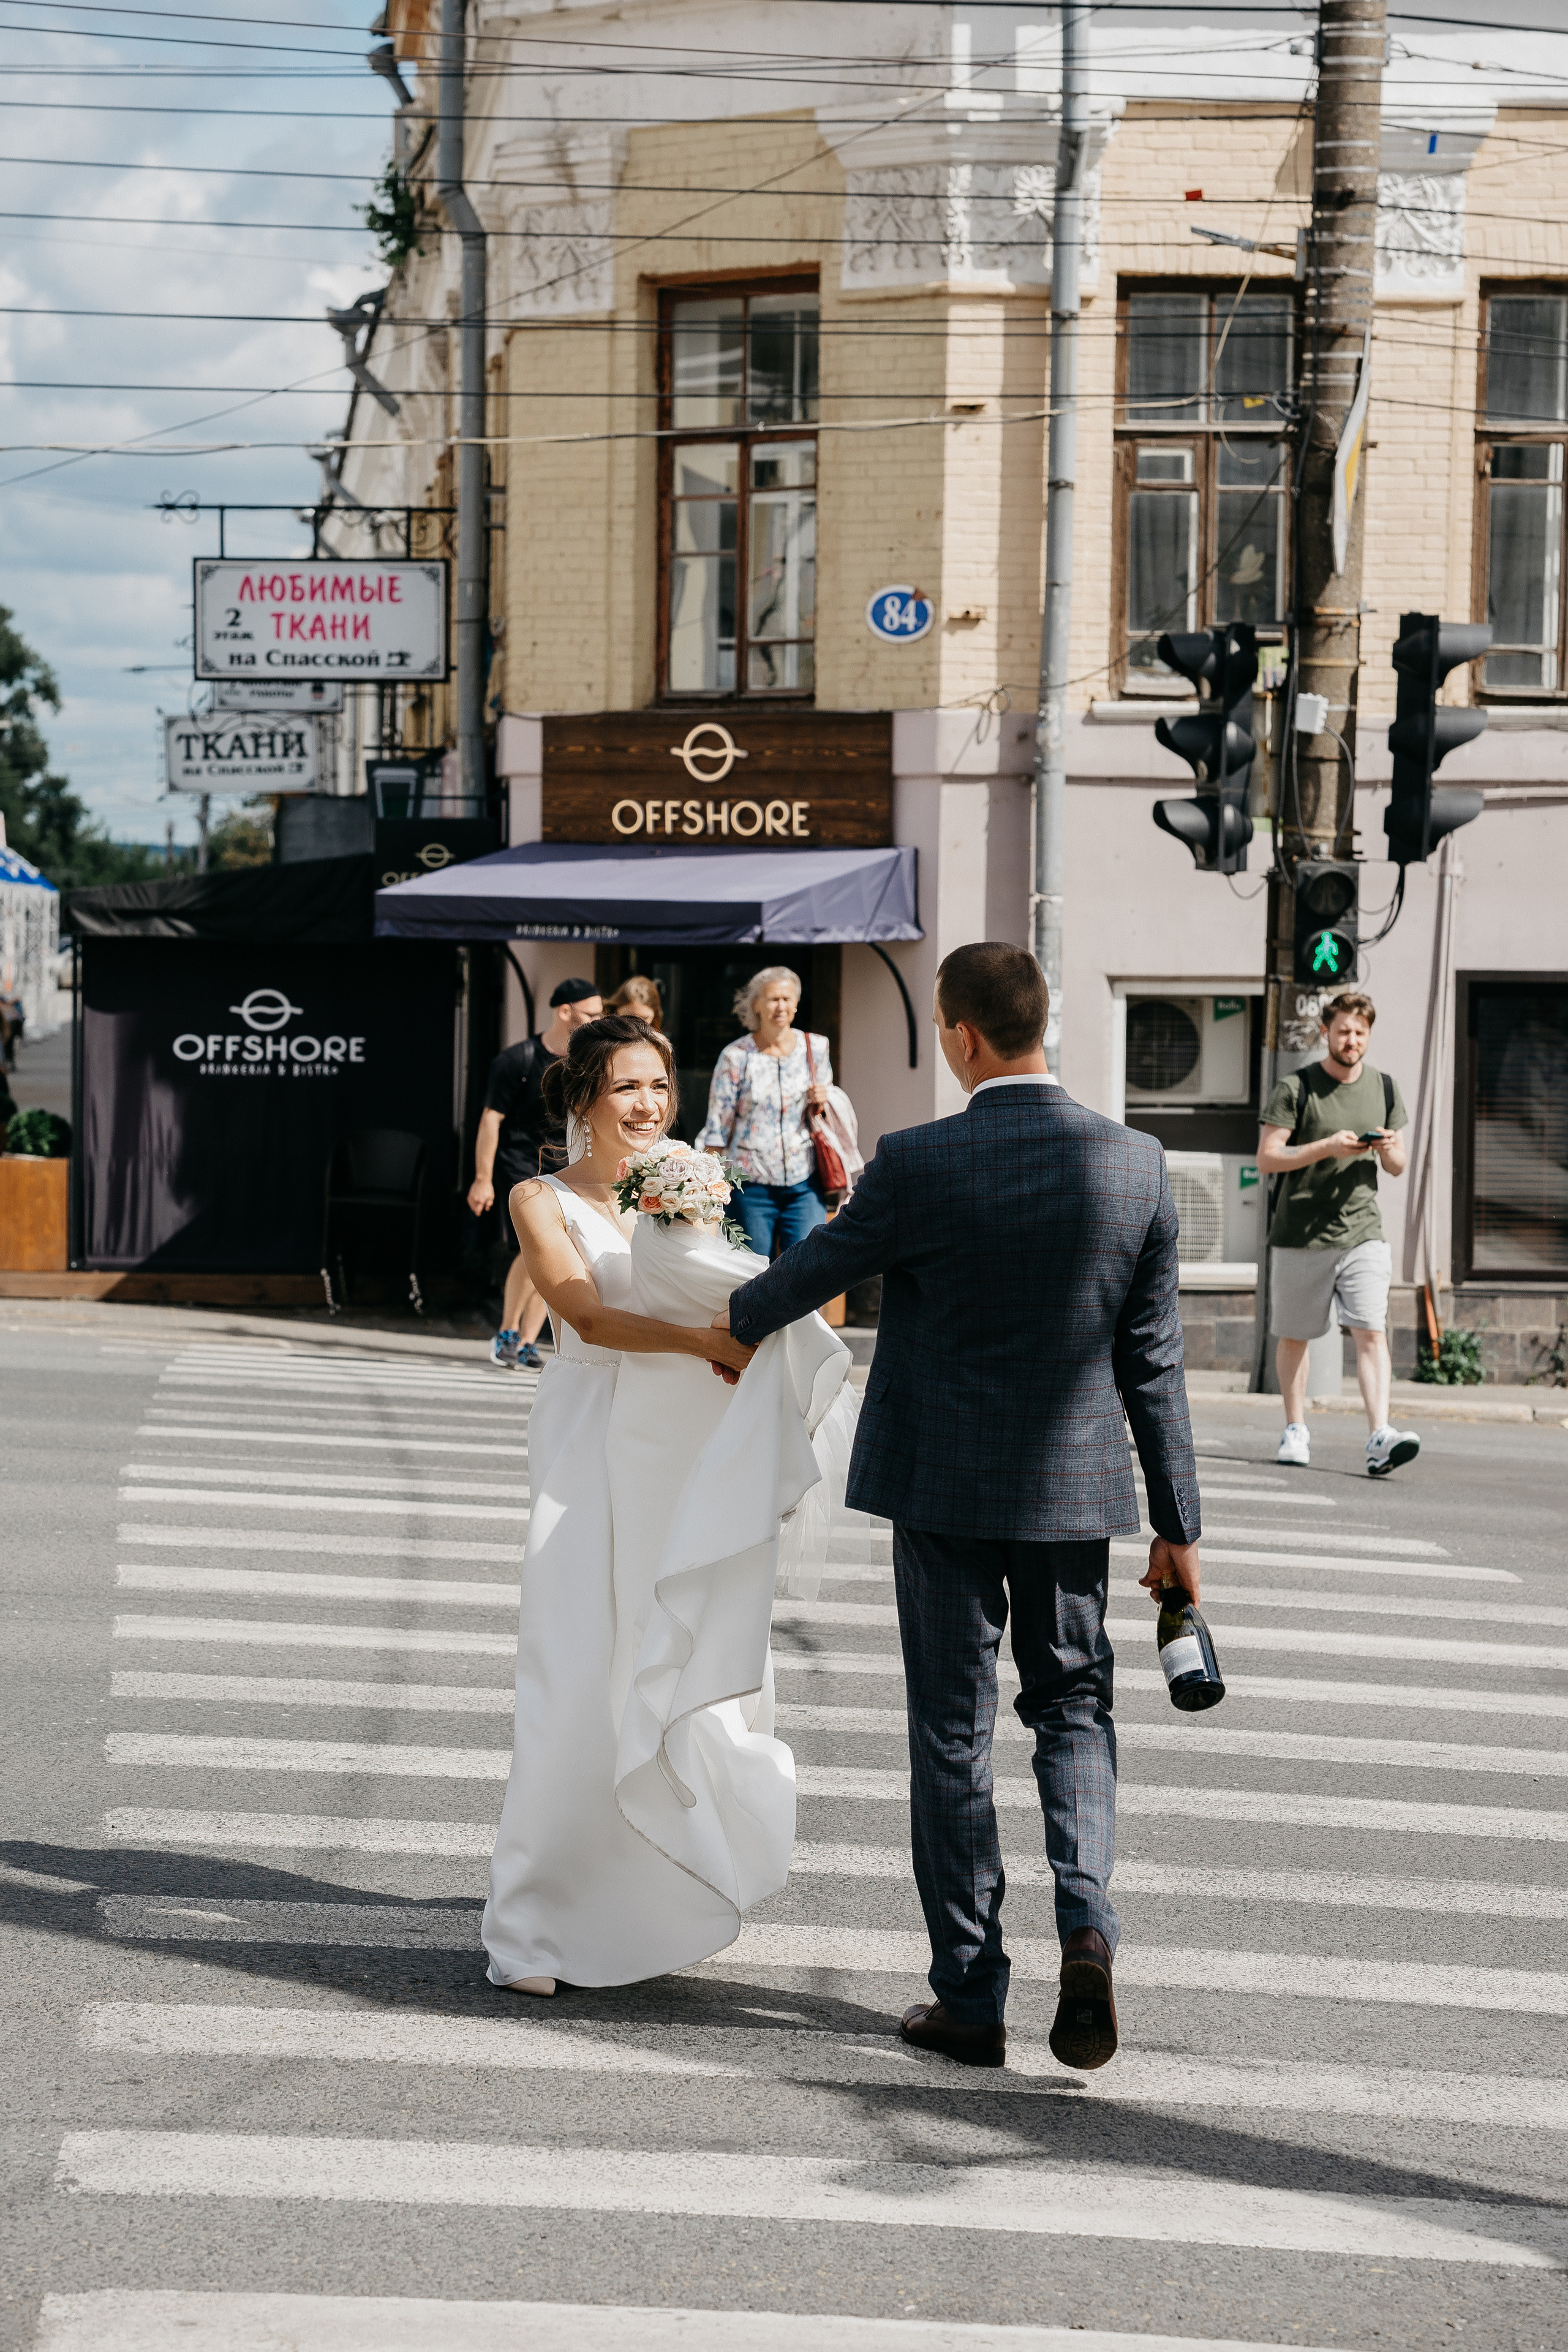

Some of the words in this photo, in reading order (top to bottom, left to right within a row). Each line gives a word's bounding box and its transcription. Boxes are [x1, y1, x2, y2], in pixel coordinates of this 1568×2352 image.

[238, 574, 403, 603] ЛЮБИМЫЕ
[225, 607, 241, 627] 2
[270, 612, 370, 641] ТКАНИ
[882, 595, 918, 632] 84
[229, 652, 257, 666] на
[265, 648, 380, 667] Спасской
[176, 731, 308, 760] ТКАНИ
[611, 799, 810, 836] OFFSHORE
[173, 1033, 366, 1062] OFFSHORE
